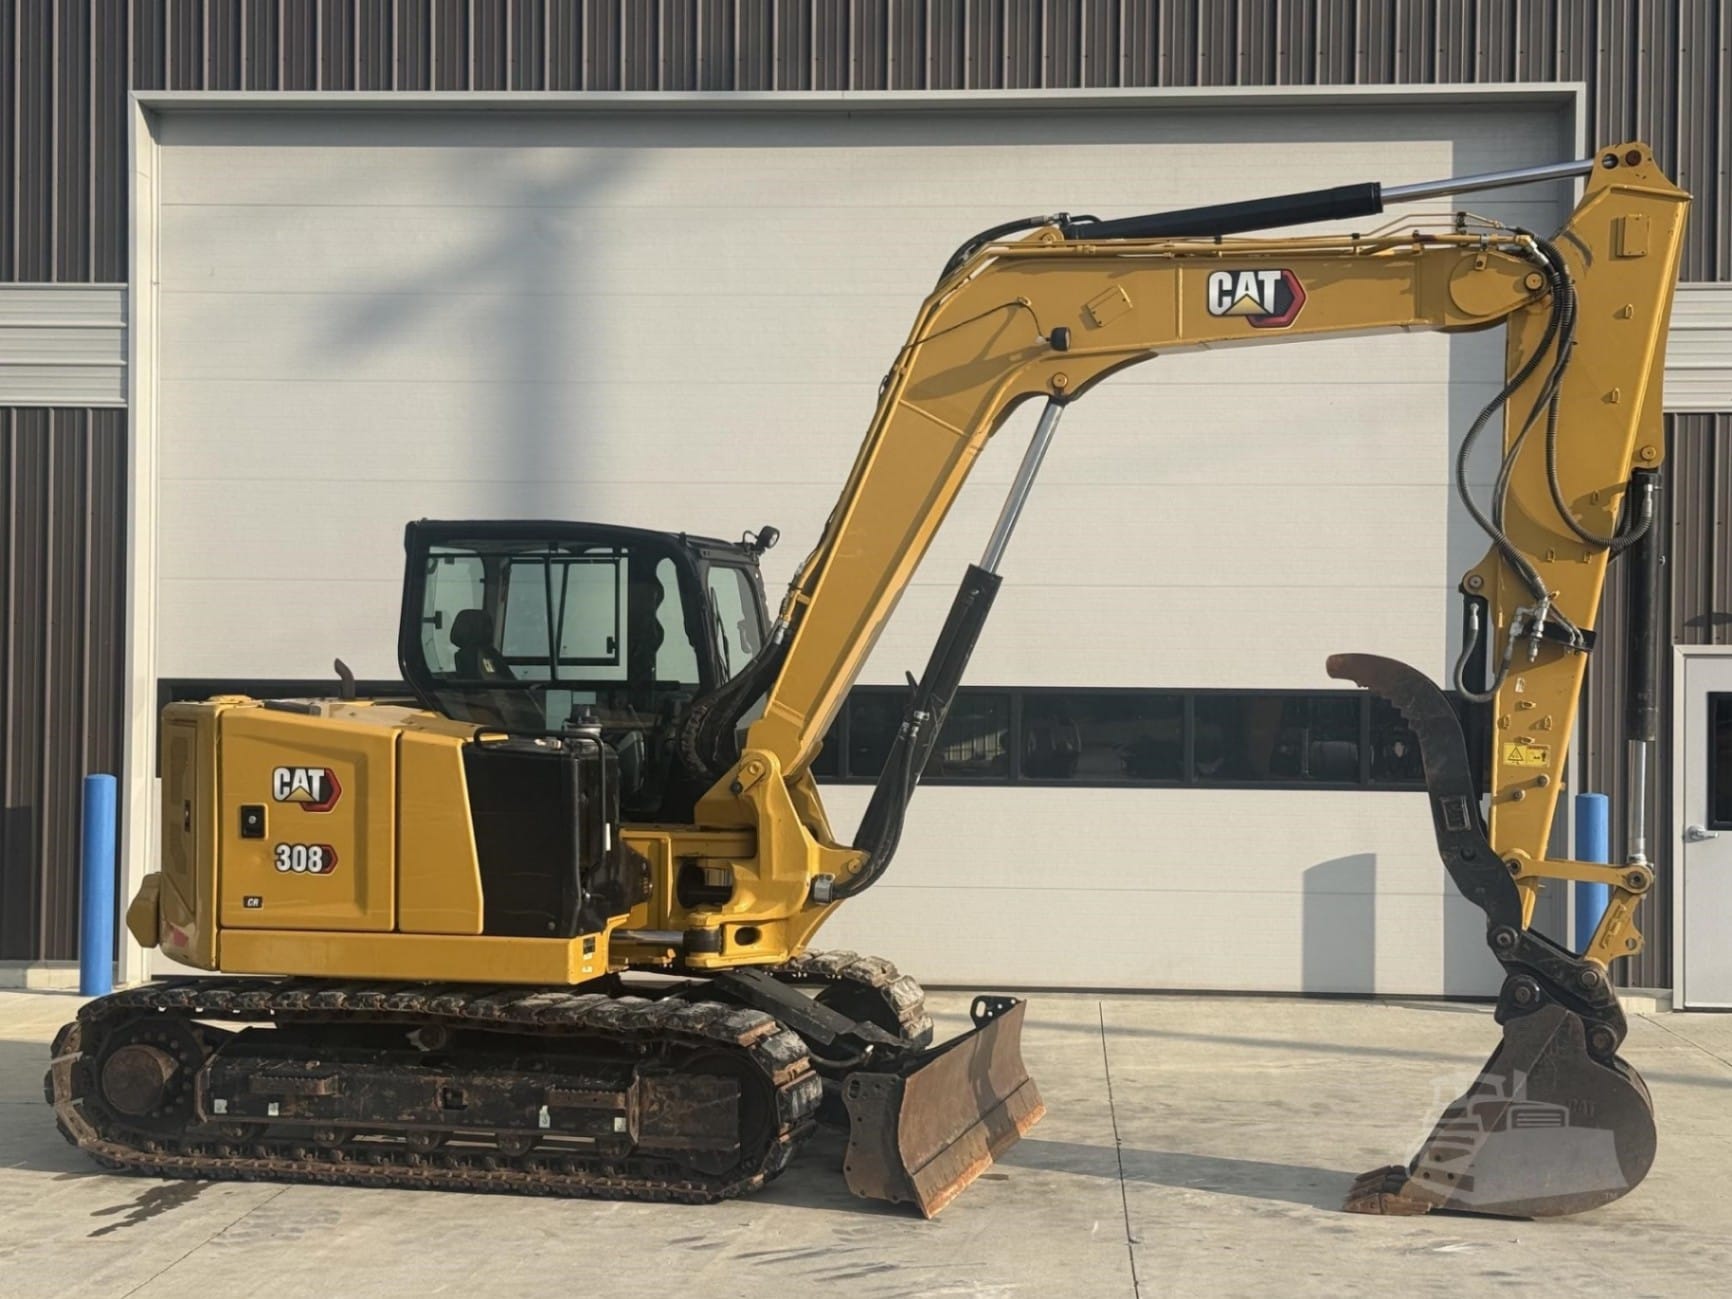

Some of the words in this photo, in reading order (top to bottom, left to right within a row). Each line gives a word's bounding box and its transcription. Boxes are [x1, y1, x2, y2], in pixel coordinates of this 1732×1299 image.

[1208, 270, 1281, 315] CAT
[273, 767, 325, 802] CAT
[276, 844, 323, 873] 308
